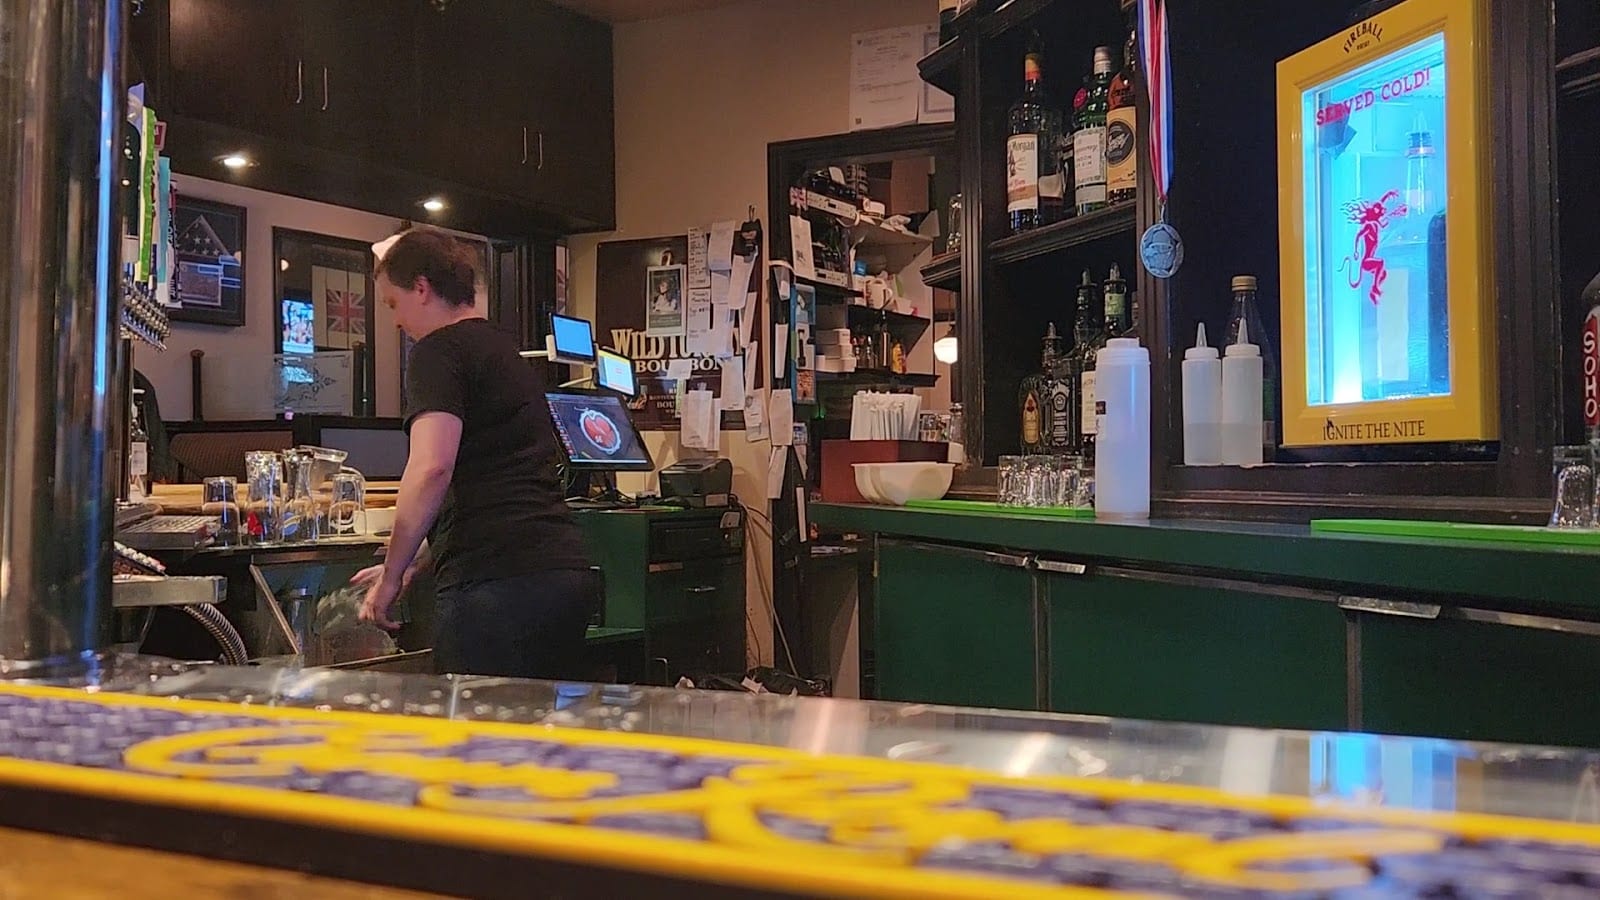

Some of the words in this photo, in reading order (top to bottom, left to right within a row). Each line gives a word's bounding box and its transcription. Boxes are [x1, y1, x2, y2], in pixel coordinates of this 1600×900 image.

[1343, 21, 1383, 53] FIREBALL
[1316, 90, 1375, 126] SERVED
[1381, 67, 1431, 100] COLD!
[611, 328, 664, 359] WILD
[1583, 331, 1597, 418] SOHO
[1323, 423, 1363, 440] IGNITE
[1365, 422, 1390, 438] THE
[1393, 420, 1425, 437] NITE
